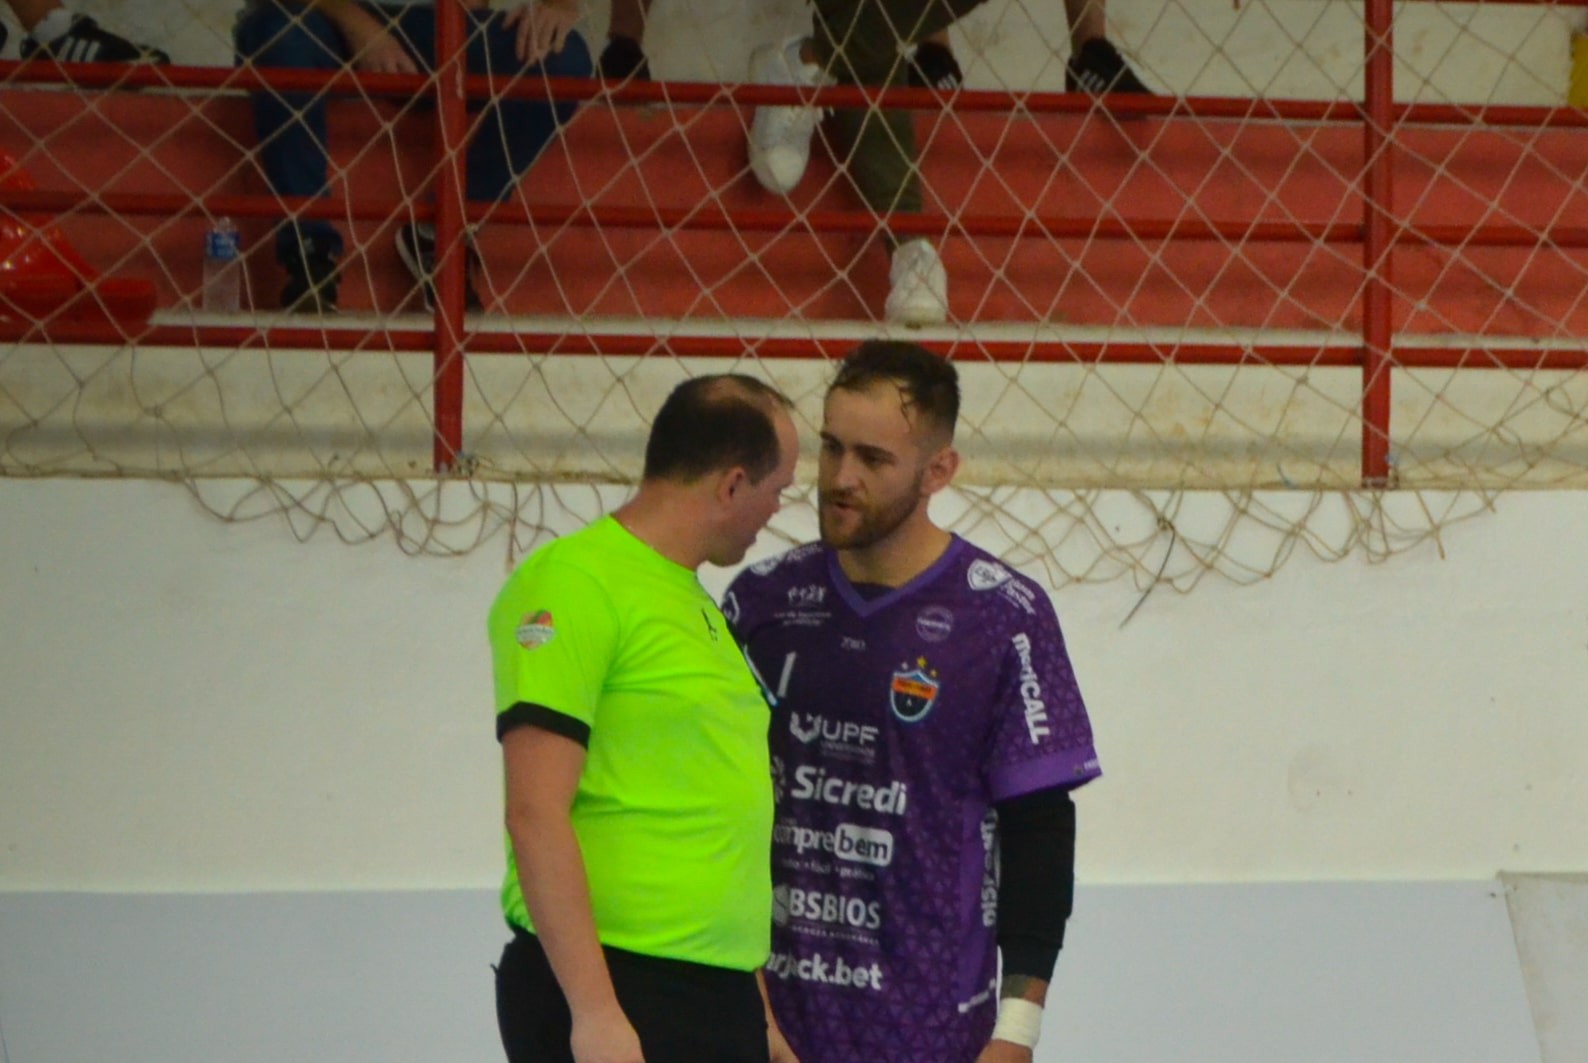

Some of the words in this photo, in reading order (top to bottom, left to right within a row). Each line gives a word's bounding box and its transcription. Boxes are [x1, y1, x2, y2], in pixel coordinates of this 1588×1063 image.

[821, 719, 879, 744] UPF
[790, 765, 908, 815] Sicredi
[790, 888, 880, 929] BSBIOS
